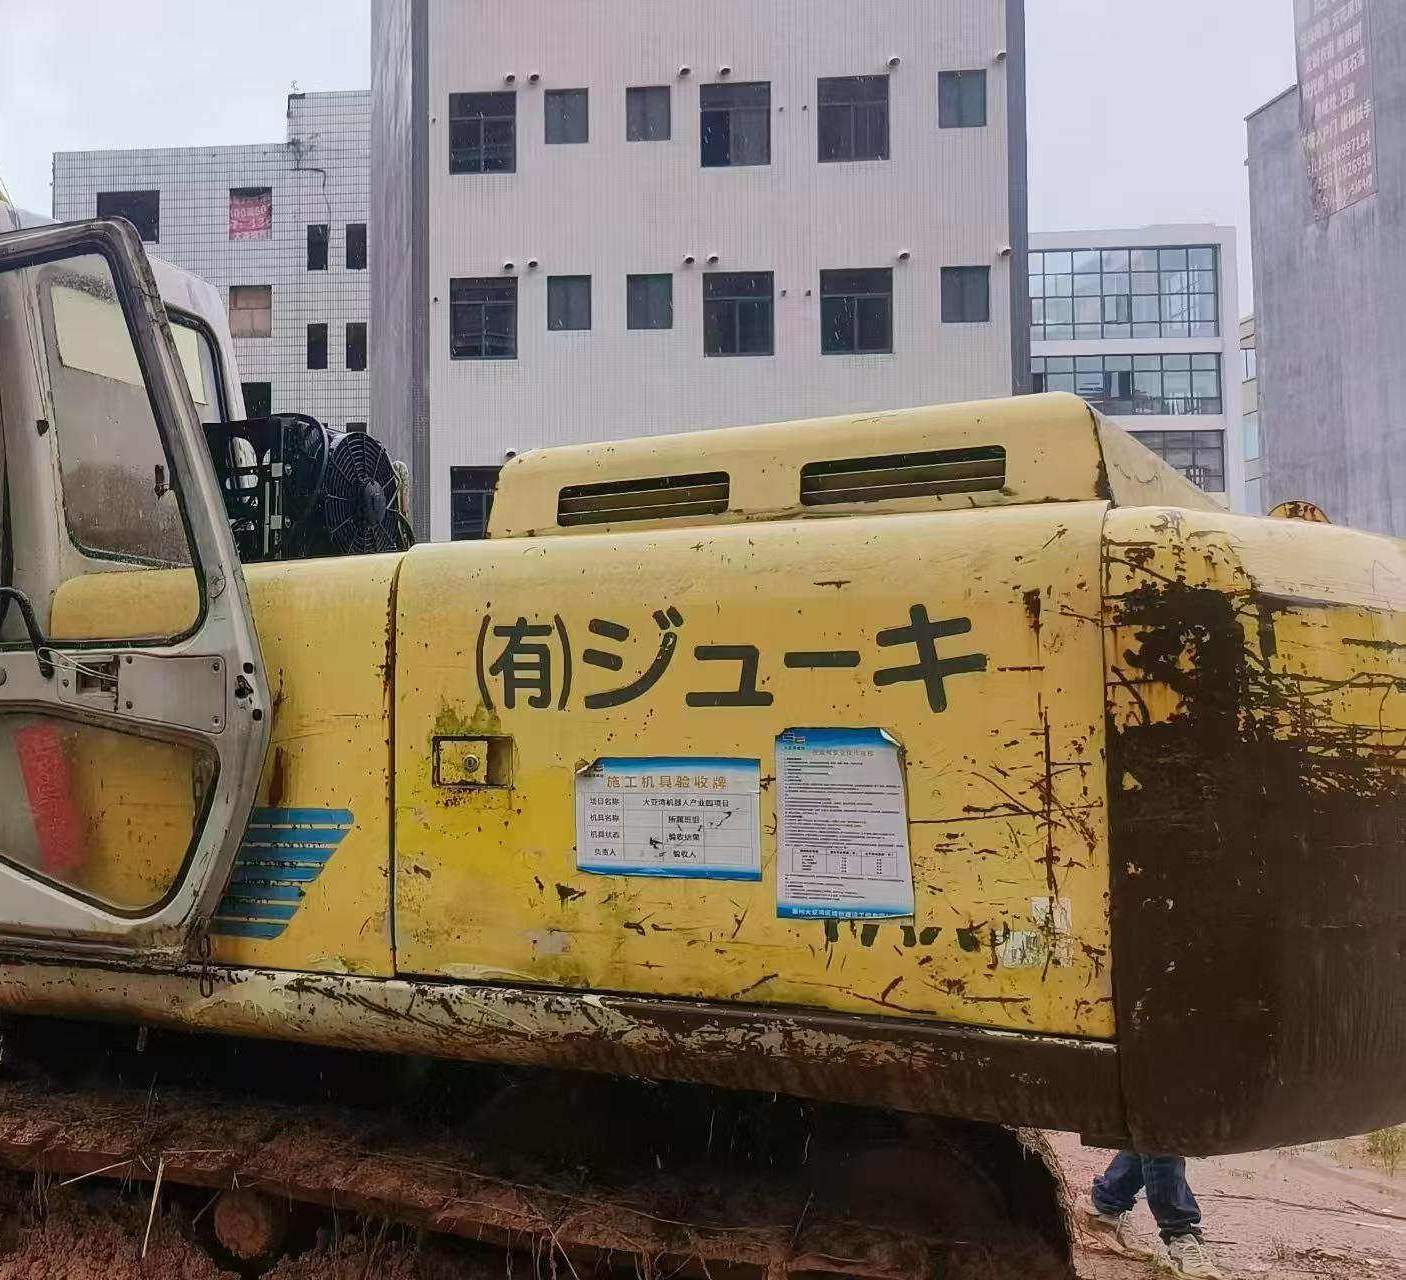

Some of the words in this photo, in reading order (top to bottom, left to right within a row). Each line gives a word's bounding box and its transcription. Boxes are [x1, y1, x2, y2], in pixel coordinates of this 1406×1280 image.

[606, 775, 728, 789] 施工机具验收牌
